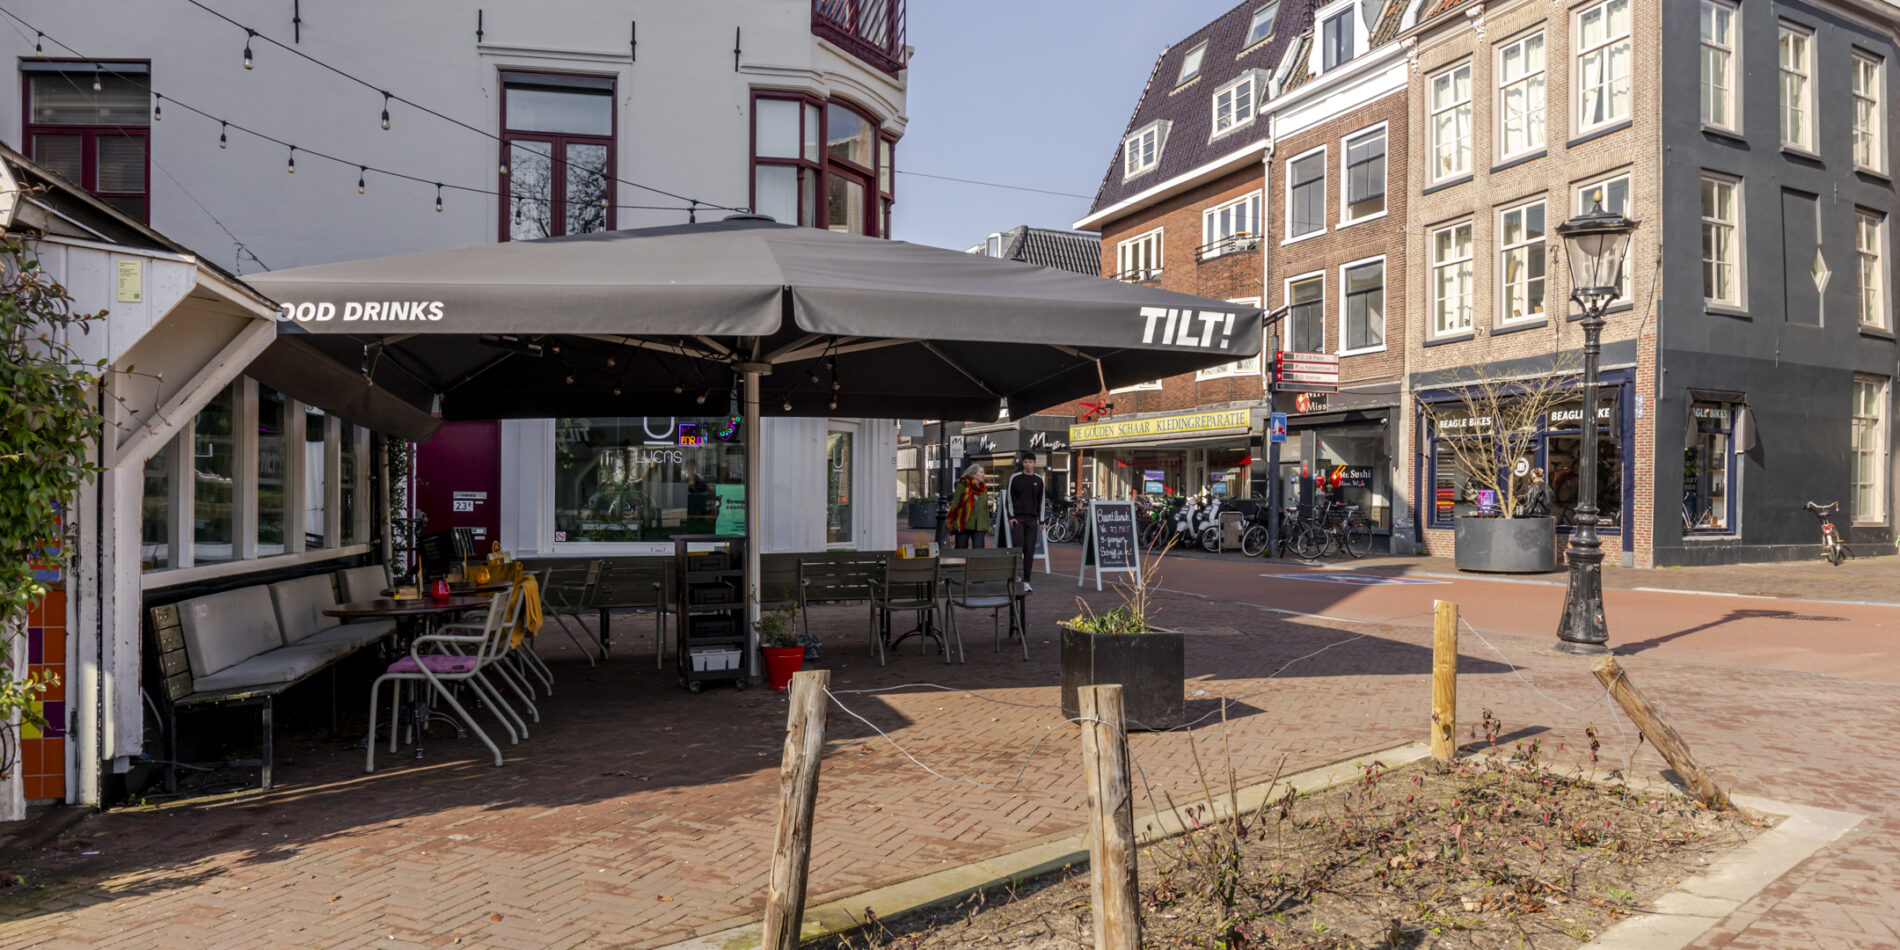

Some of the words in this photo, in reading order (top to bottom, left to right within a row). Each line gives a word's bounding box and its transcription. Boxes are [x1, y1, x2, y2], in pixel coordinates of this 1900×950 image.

[277, 302, 336, 322] OOD
[343, 301, 444, 321] DRINKS
[1139, 306, 1236, 350] TILT!
[1306, 401, 1327, 412] Miss
[1709, 408, 1728, 419] BIKES
[1073, 428, 1082, 439] DE
[1084, 426, 1114, 438] GOUDEN
[1118, 421, 1150, 435] SCHAAR
[1156, 411, 1245, 432] KLEDINGREPARATIE
[1439, 418, 1467, 428] BEAGLE
[1350, 469, 1371, 479] Sushi
